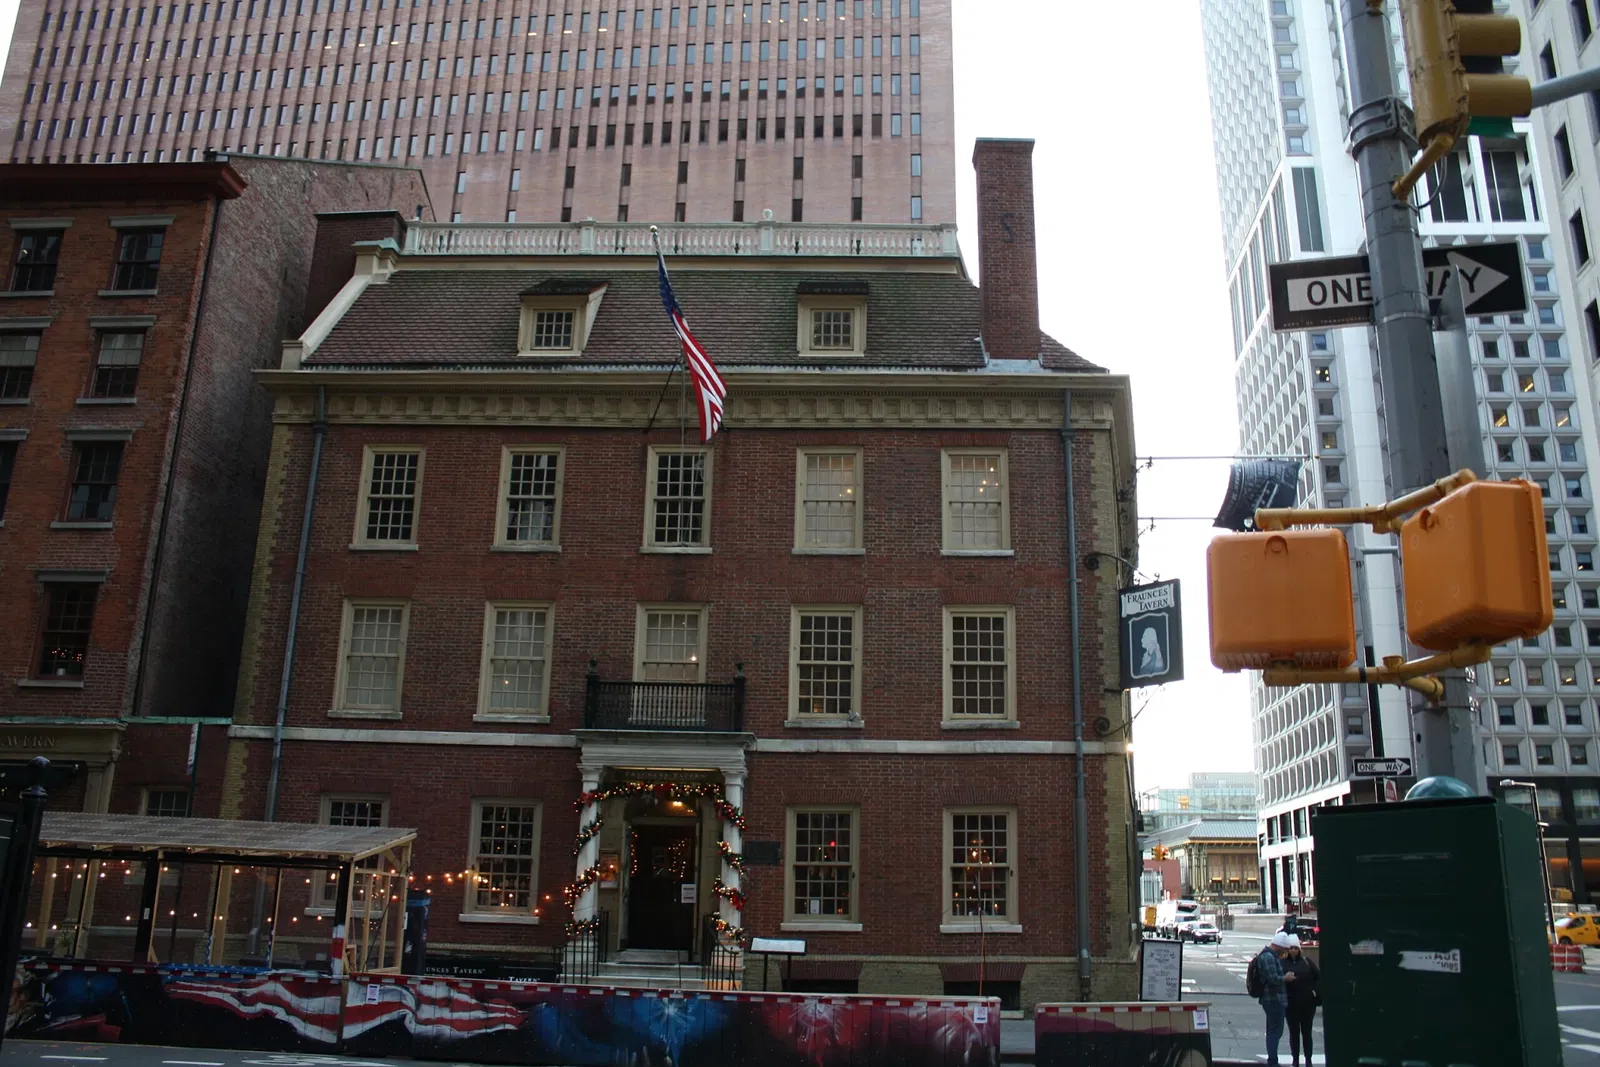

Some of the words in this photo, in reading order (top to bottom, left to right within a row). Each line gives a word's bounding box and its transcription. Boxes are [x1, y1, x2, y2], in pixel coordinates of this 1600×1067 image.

[1307, 276, 1373, 306] ONE
[1127, 588, 1168, 603] FRAUNCES
[1139, 598, 1168, 610] TAVERN
[0, 735, 55, 748] AVERN
[1359, 763, 1376, 771] ONE
[1385, 763, 1404, 771] WAY
